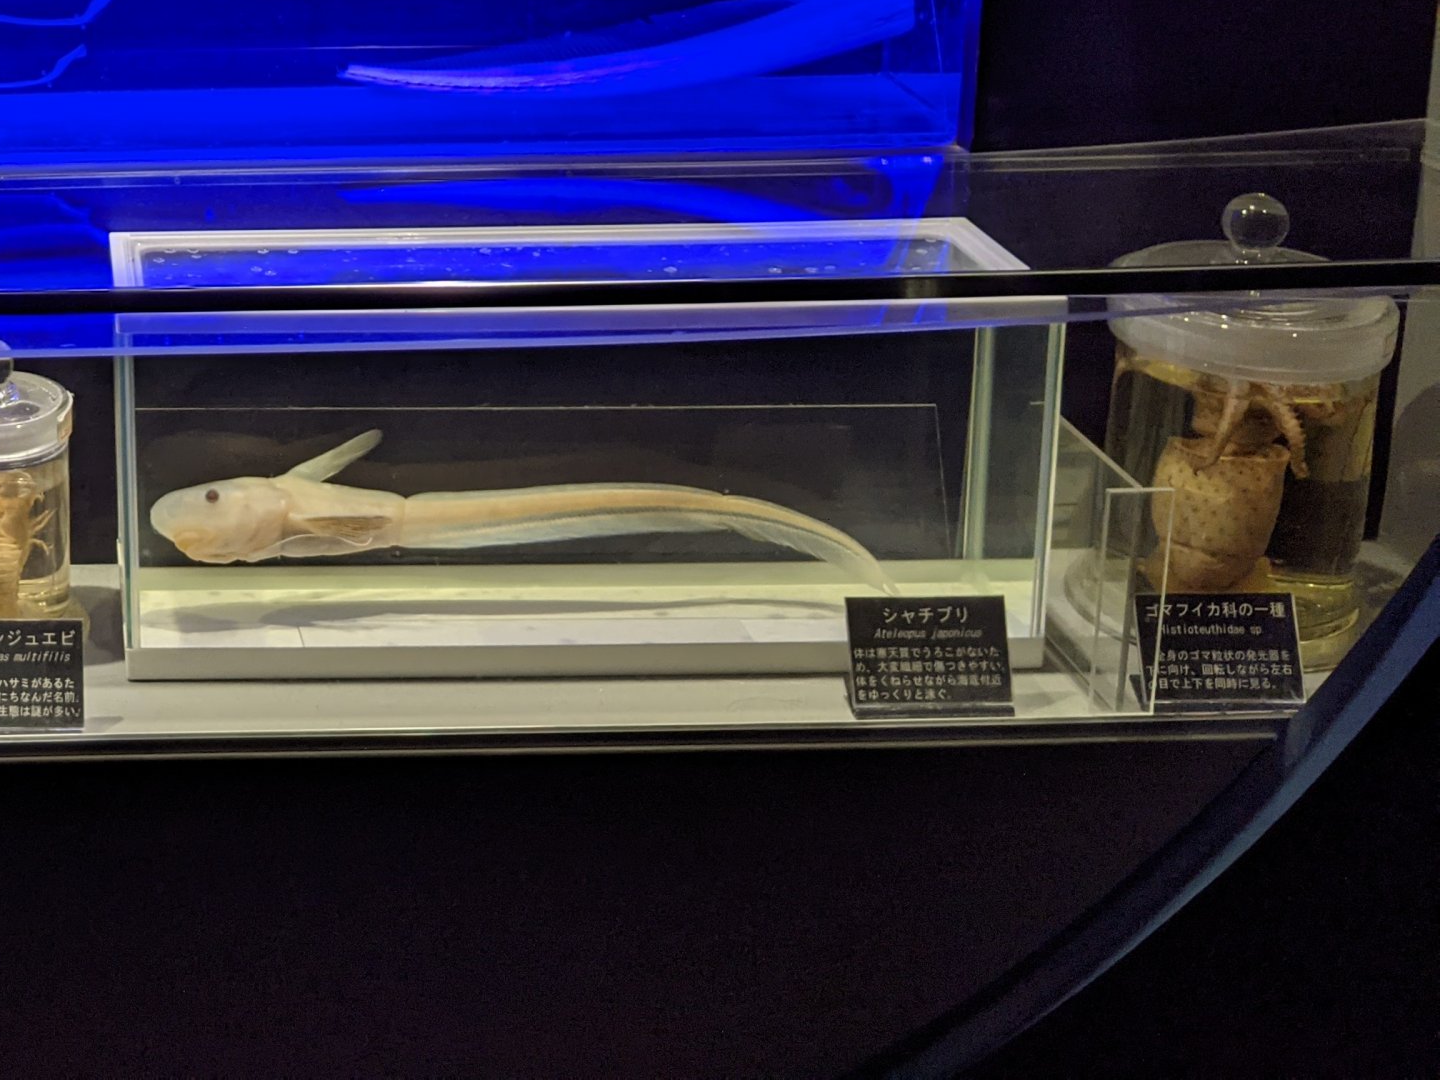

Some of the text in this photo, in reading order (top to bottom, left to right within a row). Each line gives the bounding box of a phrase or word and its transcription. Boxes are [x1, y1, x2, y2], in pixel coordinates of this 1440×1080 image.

[883, 607, 968, 624] シャチブリ
